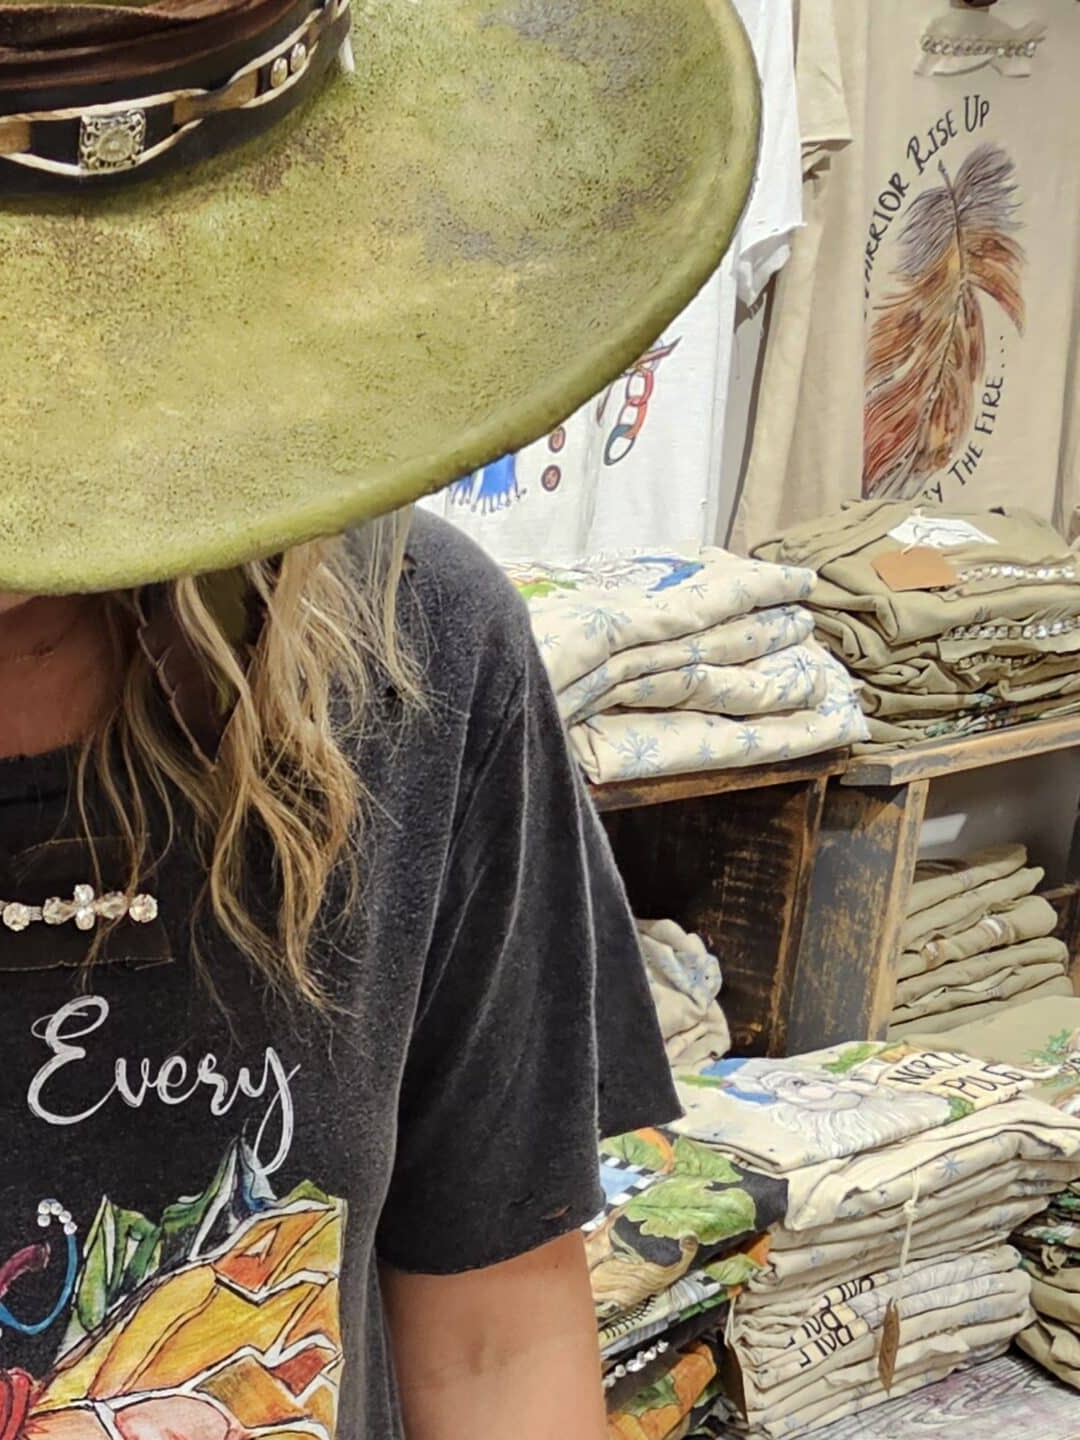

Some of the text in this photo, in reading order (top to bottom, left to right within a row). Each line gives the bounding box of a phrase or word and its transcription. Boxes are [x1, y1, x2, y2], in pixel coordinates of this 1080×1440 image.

[906, 109, 958, 176] RISE
[947, 441, 984, 485] THE
[26, 995, 301, 1175] Every
